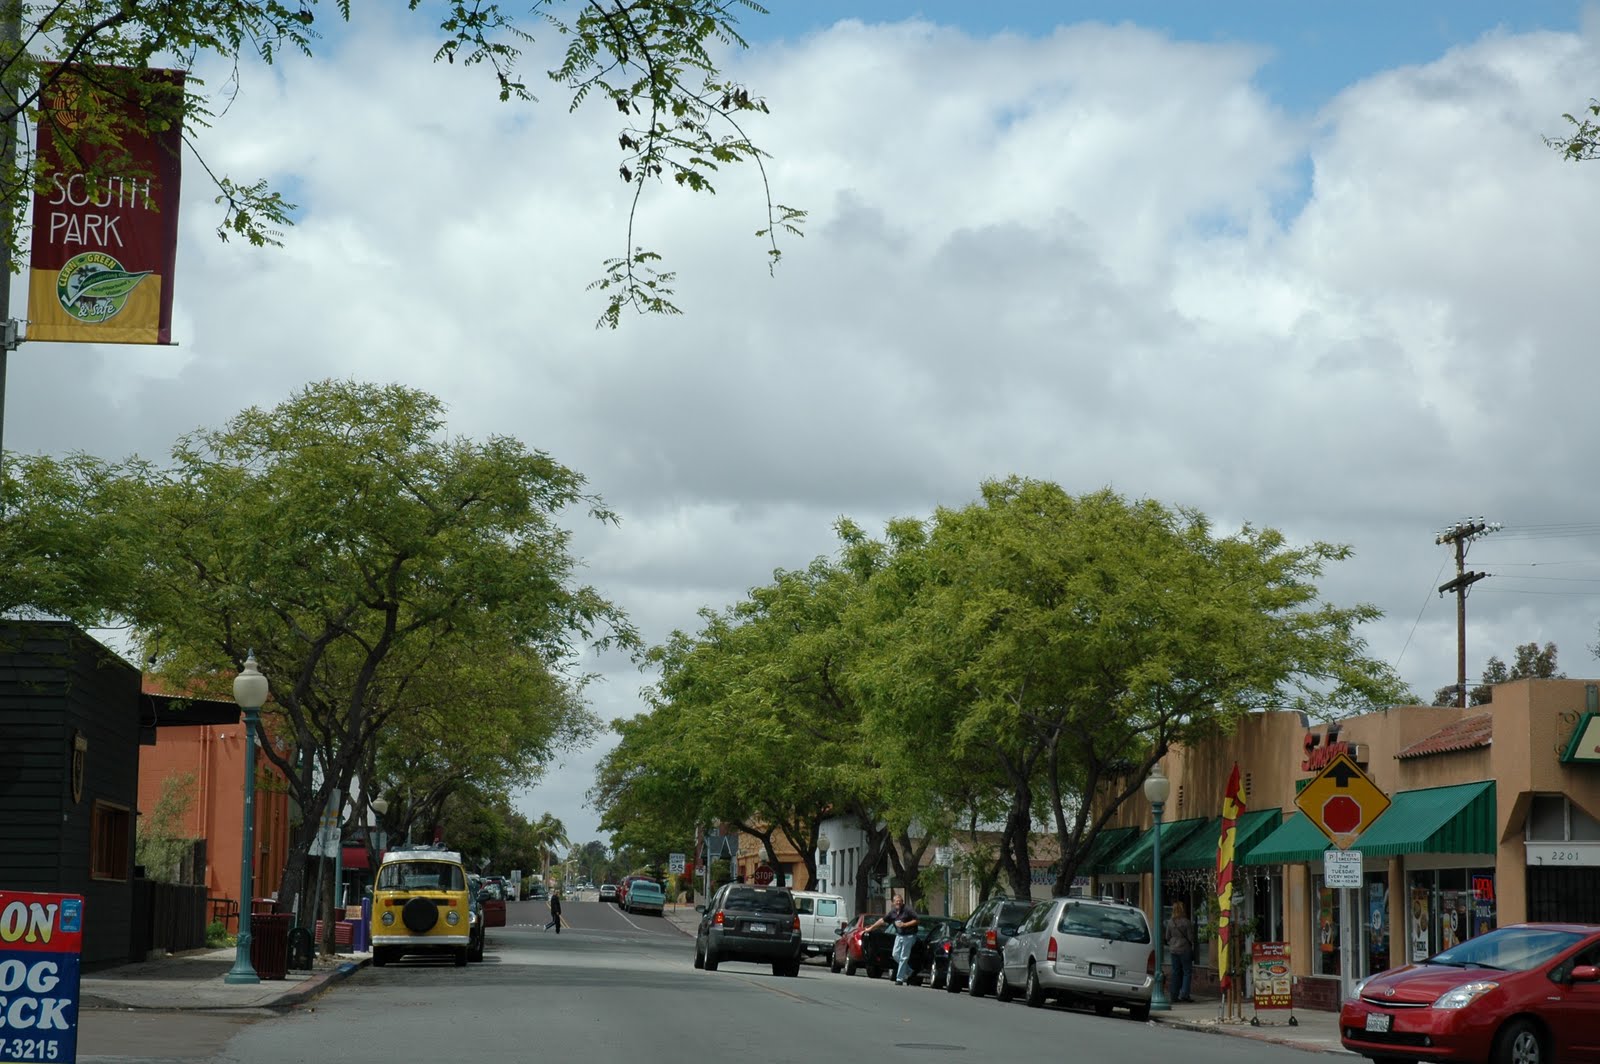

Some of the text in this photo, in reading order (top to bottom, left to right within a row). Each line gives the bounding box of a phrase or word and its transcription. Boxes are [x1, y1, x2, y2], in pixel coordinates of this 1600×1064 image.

[49, 172, 150, 210] SOUTH
[49, 212, 123, 248] PARK
[87, 254, 117, 269] GREEN
[59, 261, 77, 287] CLEAN
[1552, 851, 1579, 861] 2201
[671, 863, 684, 873] 25
[755, 871, 773, 880] STOP
[1473, 878, 1493, 900] OPEN
[0, 901, 58, 943] ON
